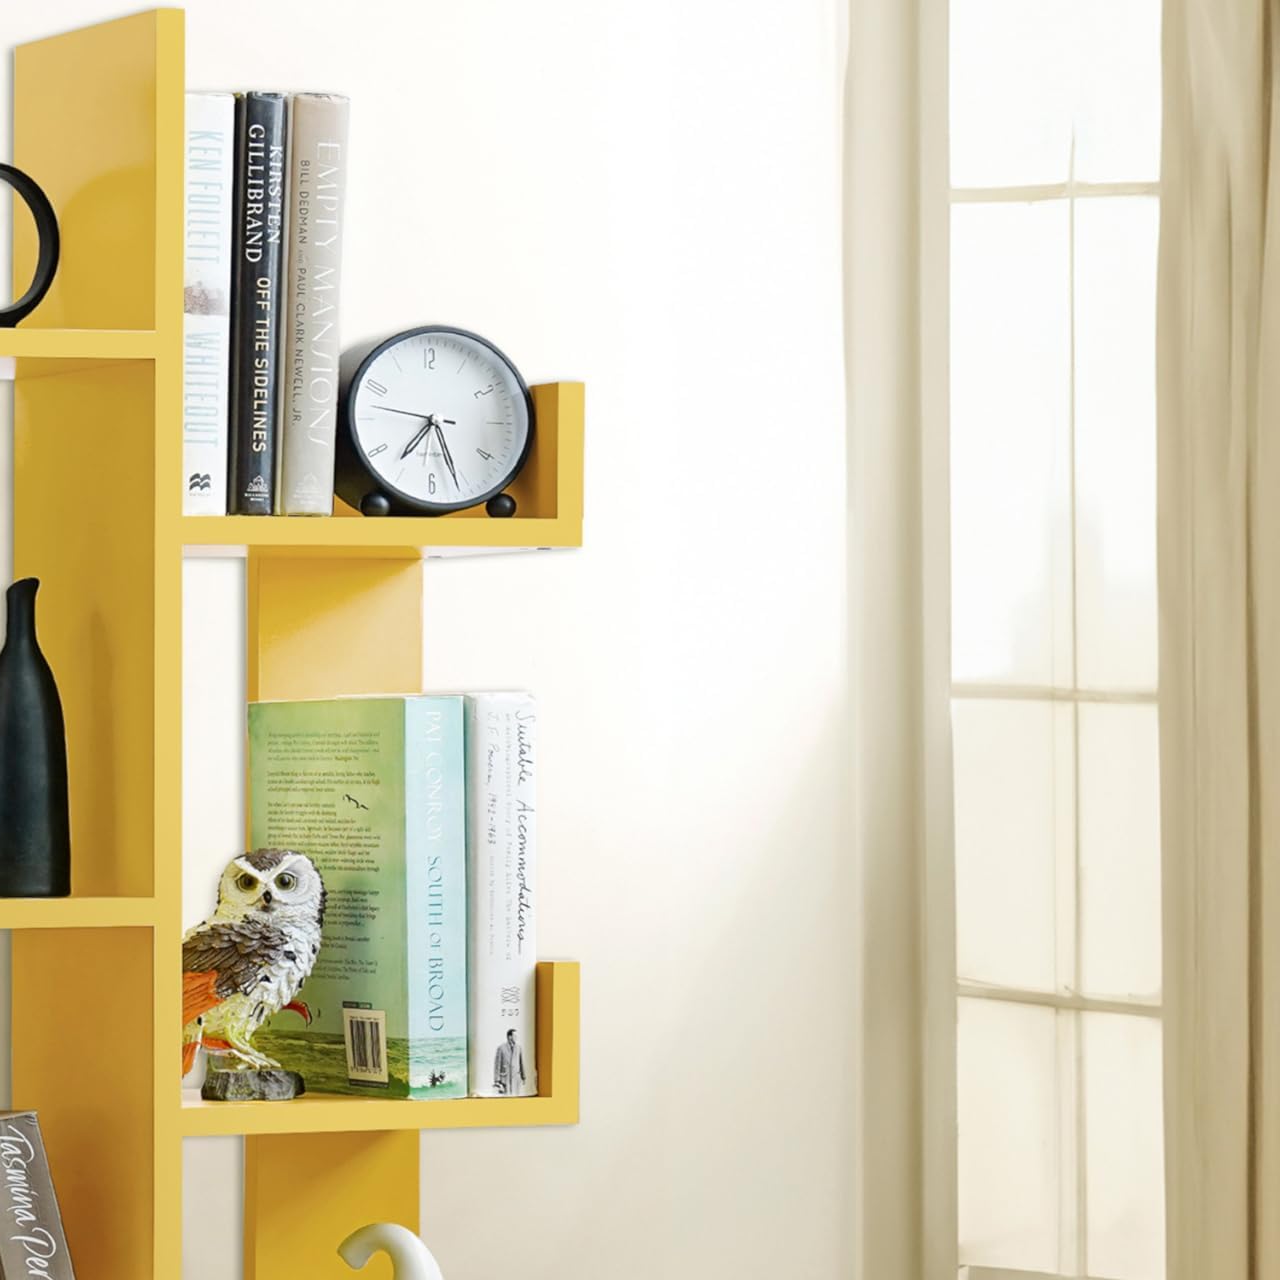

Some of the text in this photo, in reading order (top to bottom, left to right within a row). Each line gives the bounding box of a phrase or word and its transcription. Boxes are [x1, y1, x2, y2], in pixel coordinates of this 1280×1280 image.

[187, 130, 224, 264] KEN FOLLETT
[245, 124, 265, 263] GILLIBRAND
[266, 145, 283, 244] KIRSTEN
[299, 160, 310, 185] BILL
[298, 191, 310, 244] DEDMAN
[296, 268, 307, 297] PAUL
[309, 142, 342, 447] EMPTY MANSIONS
[295, 304, 306, 344] CLARK
[424, 348, 436, 370] 12
[184, 332, 221, 448] WHITEOUT
[252, 277, 271, 453] OFF THE SIDELINES
[365, 379, 388, 397] 10
[474, 385, 494, 399] 2
[428, 473, 436, 495] 6
[477, 448, 494, 460] 4
[425, 751, 442, 842] CONROY
[515, 710, 536, 956] Suitable Accommodations
[427, 856, 443, 926] SOUTH
[428, 957, 444, 1032] BROAD
